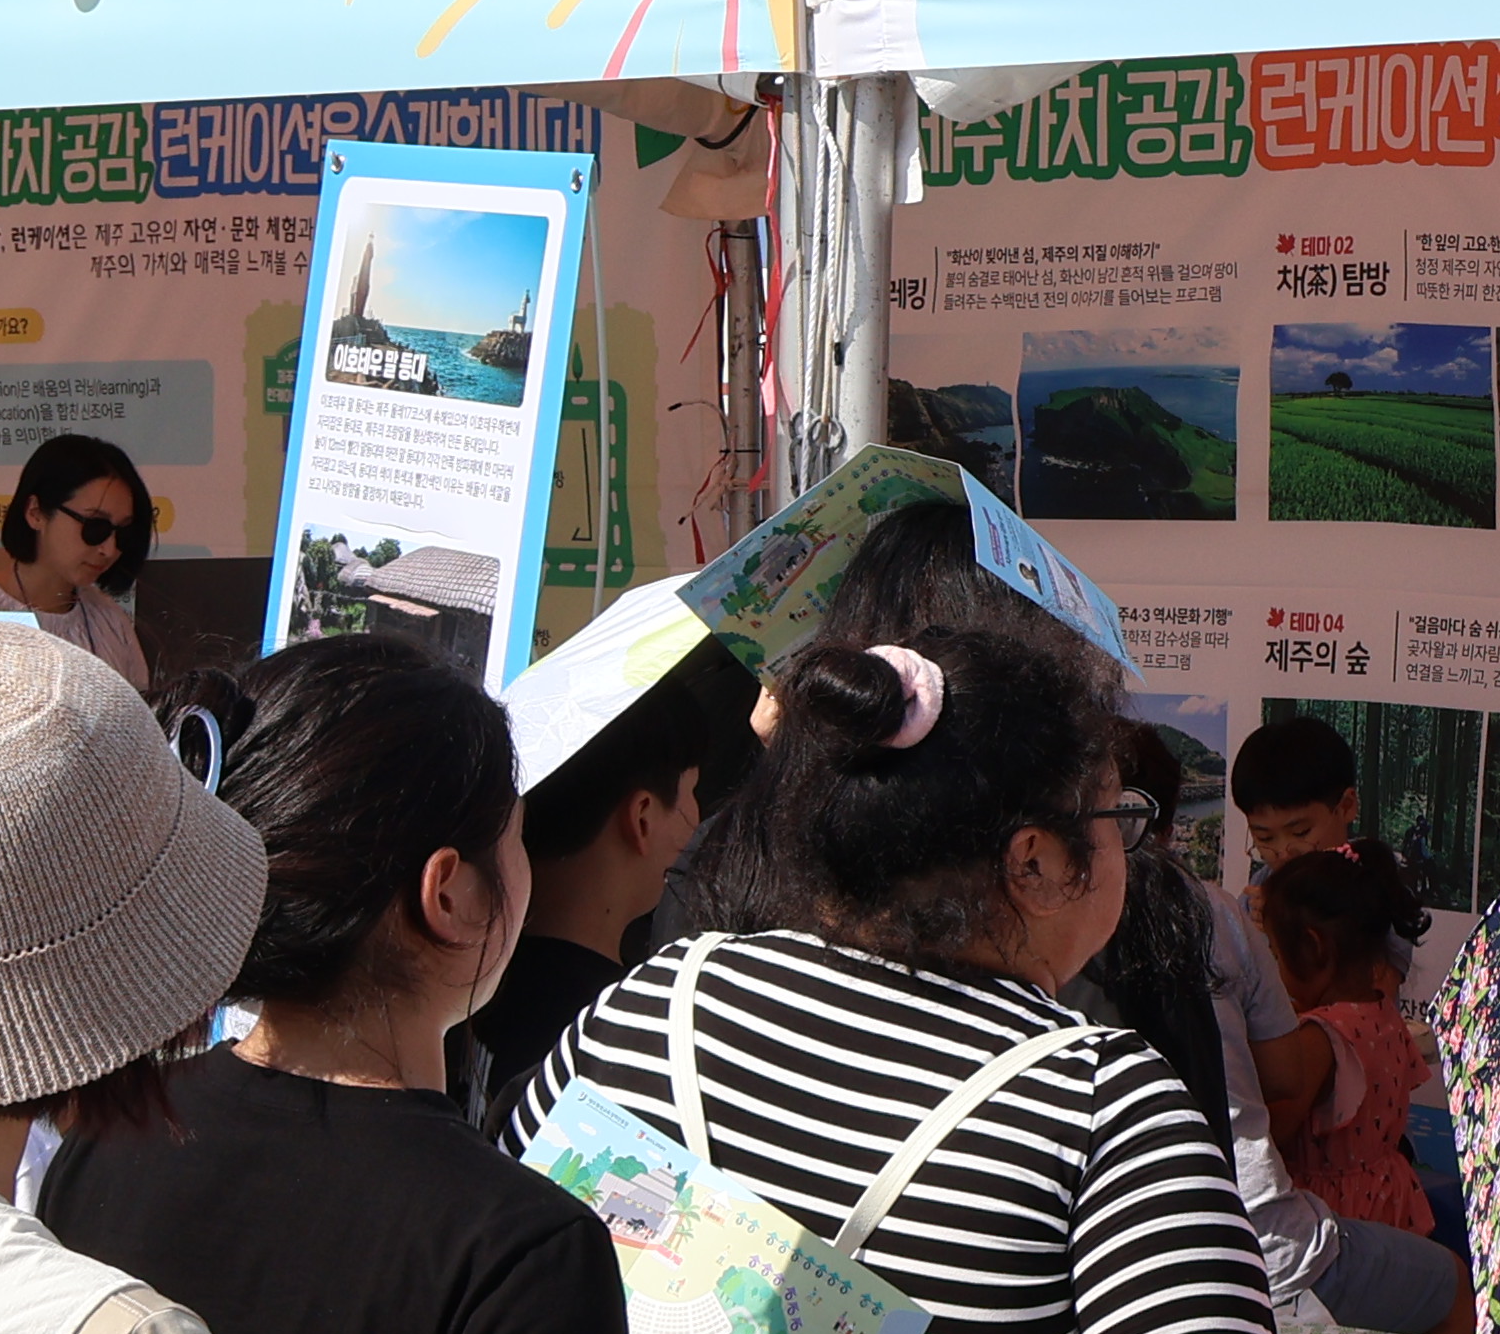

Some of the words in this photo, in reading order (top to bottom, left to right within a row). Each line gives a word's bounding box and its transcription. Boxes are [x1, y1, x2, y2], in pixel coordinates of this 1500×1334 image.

[1124, 62, 1246, 168] 공감,
[1256, 51, 1488, 158] 런케이션
[61, 111, 151, 194] 공감,
[11, 223, 87, 253] 런케이션은
[95, 221, 124, 246] 제주
[129, 218, 177, 244] 고유의
[1300, 237, 1331, 257] 테마
[1333, 237, 1355, 255] 02
[1435, 234, 1460, 253] 잎의
[90, 253, 136, 278] 제주의
[141, 250, 187, 276] 가치와
[195, 248, 240, 274] 매력을
[246, 248, 287, 274] 느껴볼
[293, 250, 308, 273] 수
[1022, 246, 1039, 265] 섬,
[1041, 244, 1079, 264] 제주의
[1082, 244, 1108, 262] 지질
[968, 269, 1001, 287] 숨결로
[1002, 269, 1039, 287] 태어난
[1041, 268, 1058, 287] 섬,
[1059, 267, 1095, 285] 화산이
[1120, 264, 1145, 283] 흔적
[1147, 264, 1175, 282] 위를
[1176, 262, 1212, 281] 걸으며
[1342, 260, 1390, 297] 탐방
[1415, 258, 1440, 277] 청정
[1441, 258, 1481, 278] 제주의
[943, 293, 988, 312] 들려주는
[989, 292, 1040, 310] 수백만년
[1043, 291, 1068, 309] 전의
[1070, 289, 1116, 308] 이야기를
[1117, 288, 1174, 306] 들어보는
[1175, 285, 1223, 304] 프로그램
[1415, 282, 1451, 301] 따뜻한
[1452, 283, 1479, 301] 커피
[400, 354, 428, 383] 등대
[32, 379, 73, 398] 배움의
[1152, 607, 1201, 625] 역사문화
[1289, 611, 1321, 633] 테마
[1323, 614, 1346, 634] 04
[1153, 630, 1202, 648] 감수성을
[1203, 631, 1229, 649] 따라
[1468, 618, 1483, 639] 숨
[1142, 652, 1191, 671] 프로그램
[1264, 638, 1337, 675] 제주의
[1345, 640, 1371, 675] 숲
[1407, 639, 1459, 660] 곶자왈과
[1462, 640, 1500, 663] 비자림
[1406, 664, 1444, 684] 연결을
[1446, 665, 1490, 688] 느끼고,
